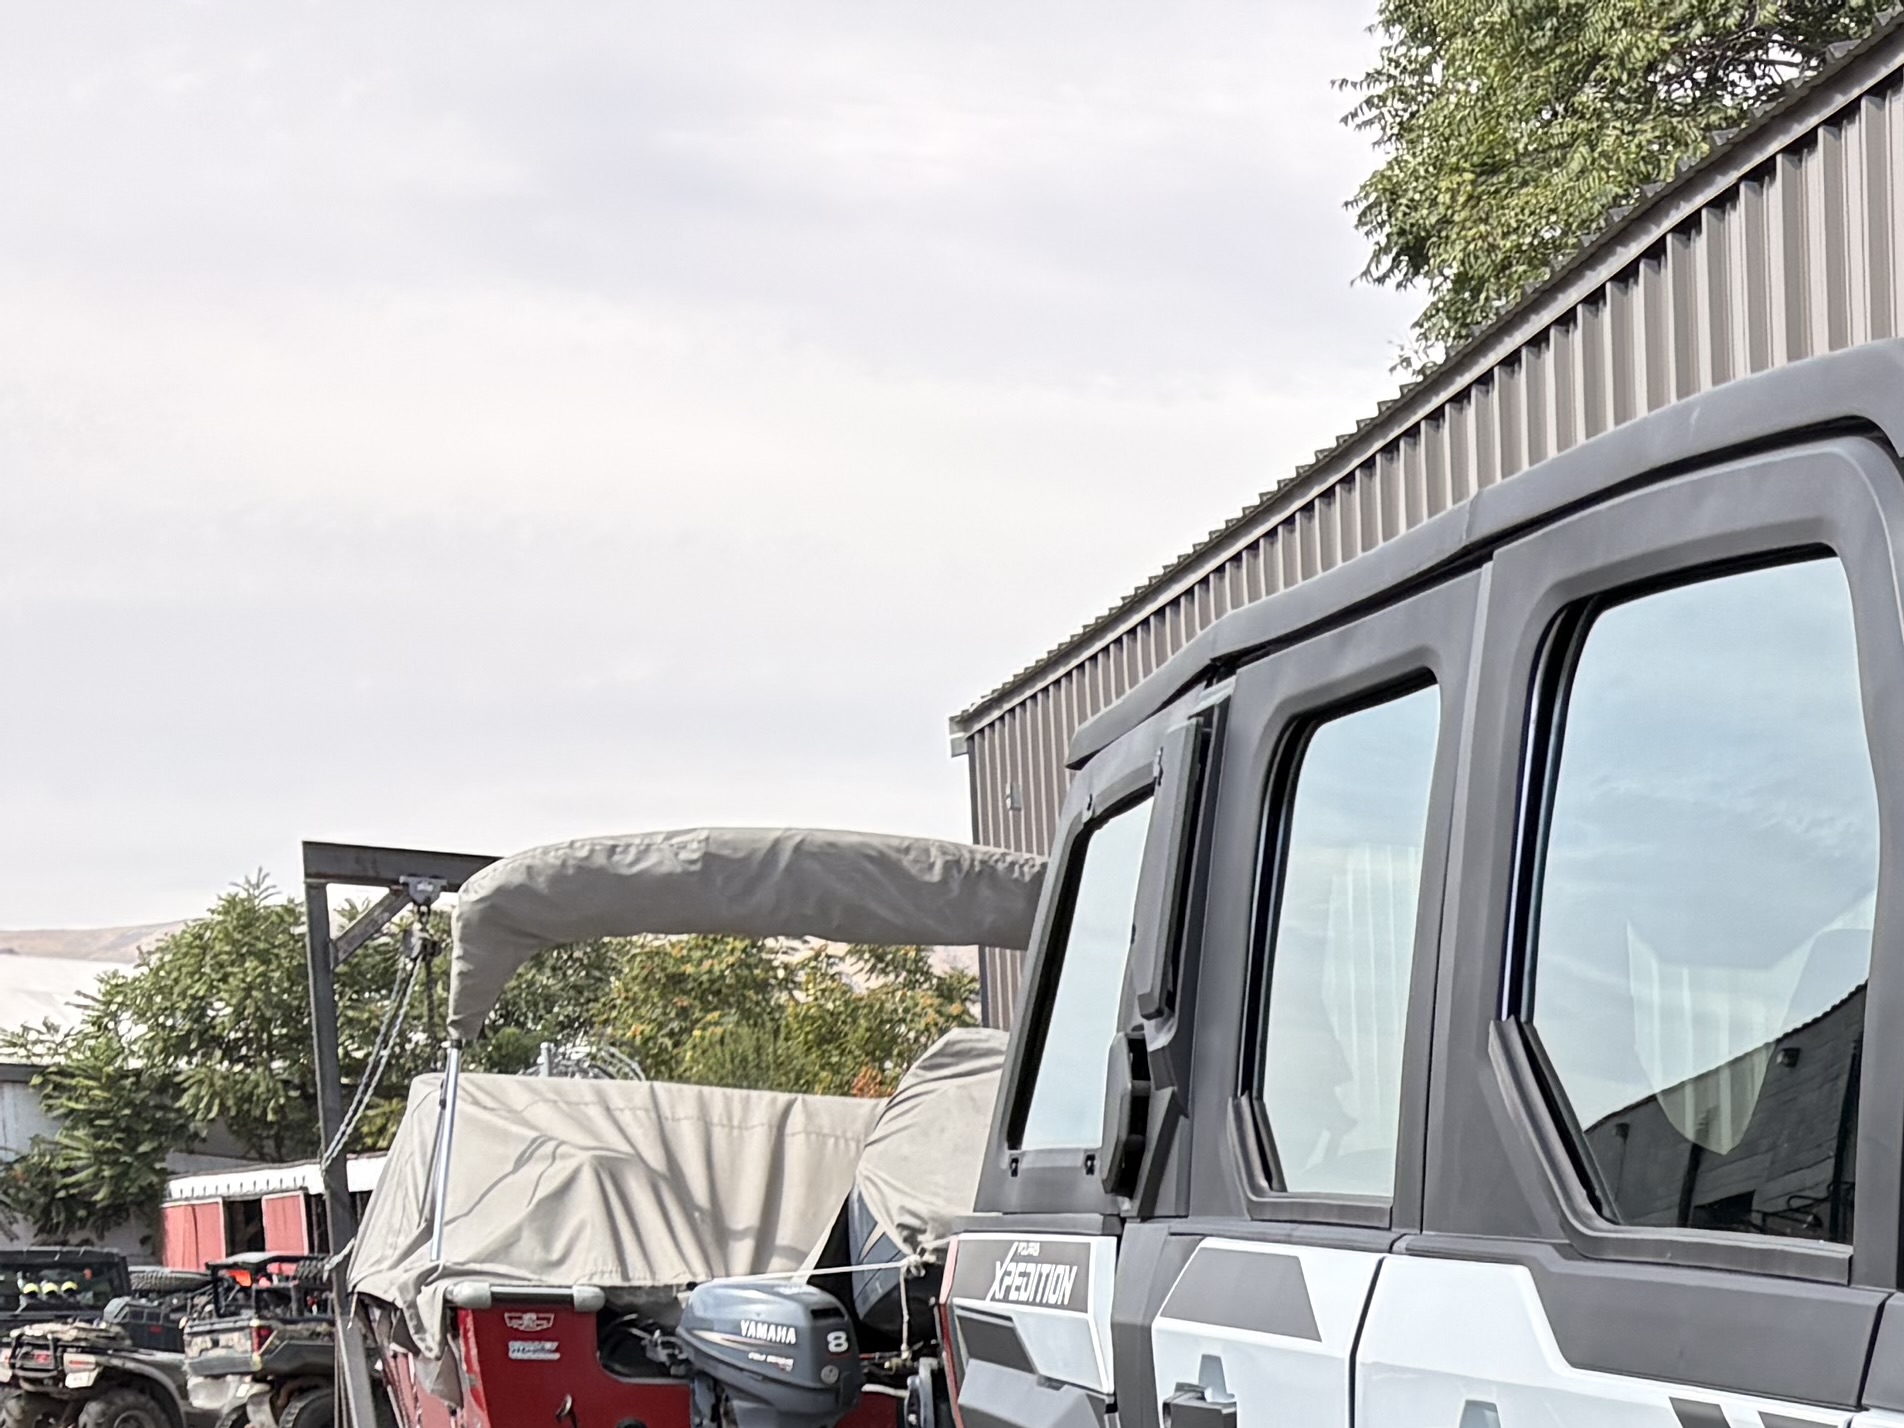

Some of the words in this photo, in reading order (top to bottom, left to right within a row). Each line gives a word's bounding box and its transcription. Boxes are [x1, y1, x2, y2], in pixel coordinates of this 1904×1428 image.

[985, 1241, 1078, 1305] XPEDITION
[740, 1319, 797, 1345] YAMAHA
[826, 1330, 849, 1353] 8
